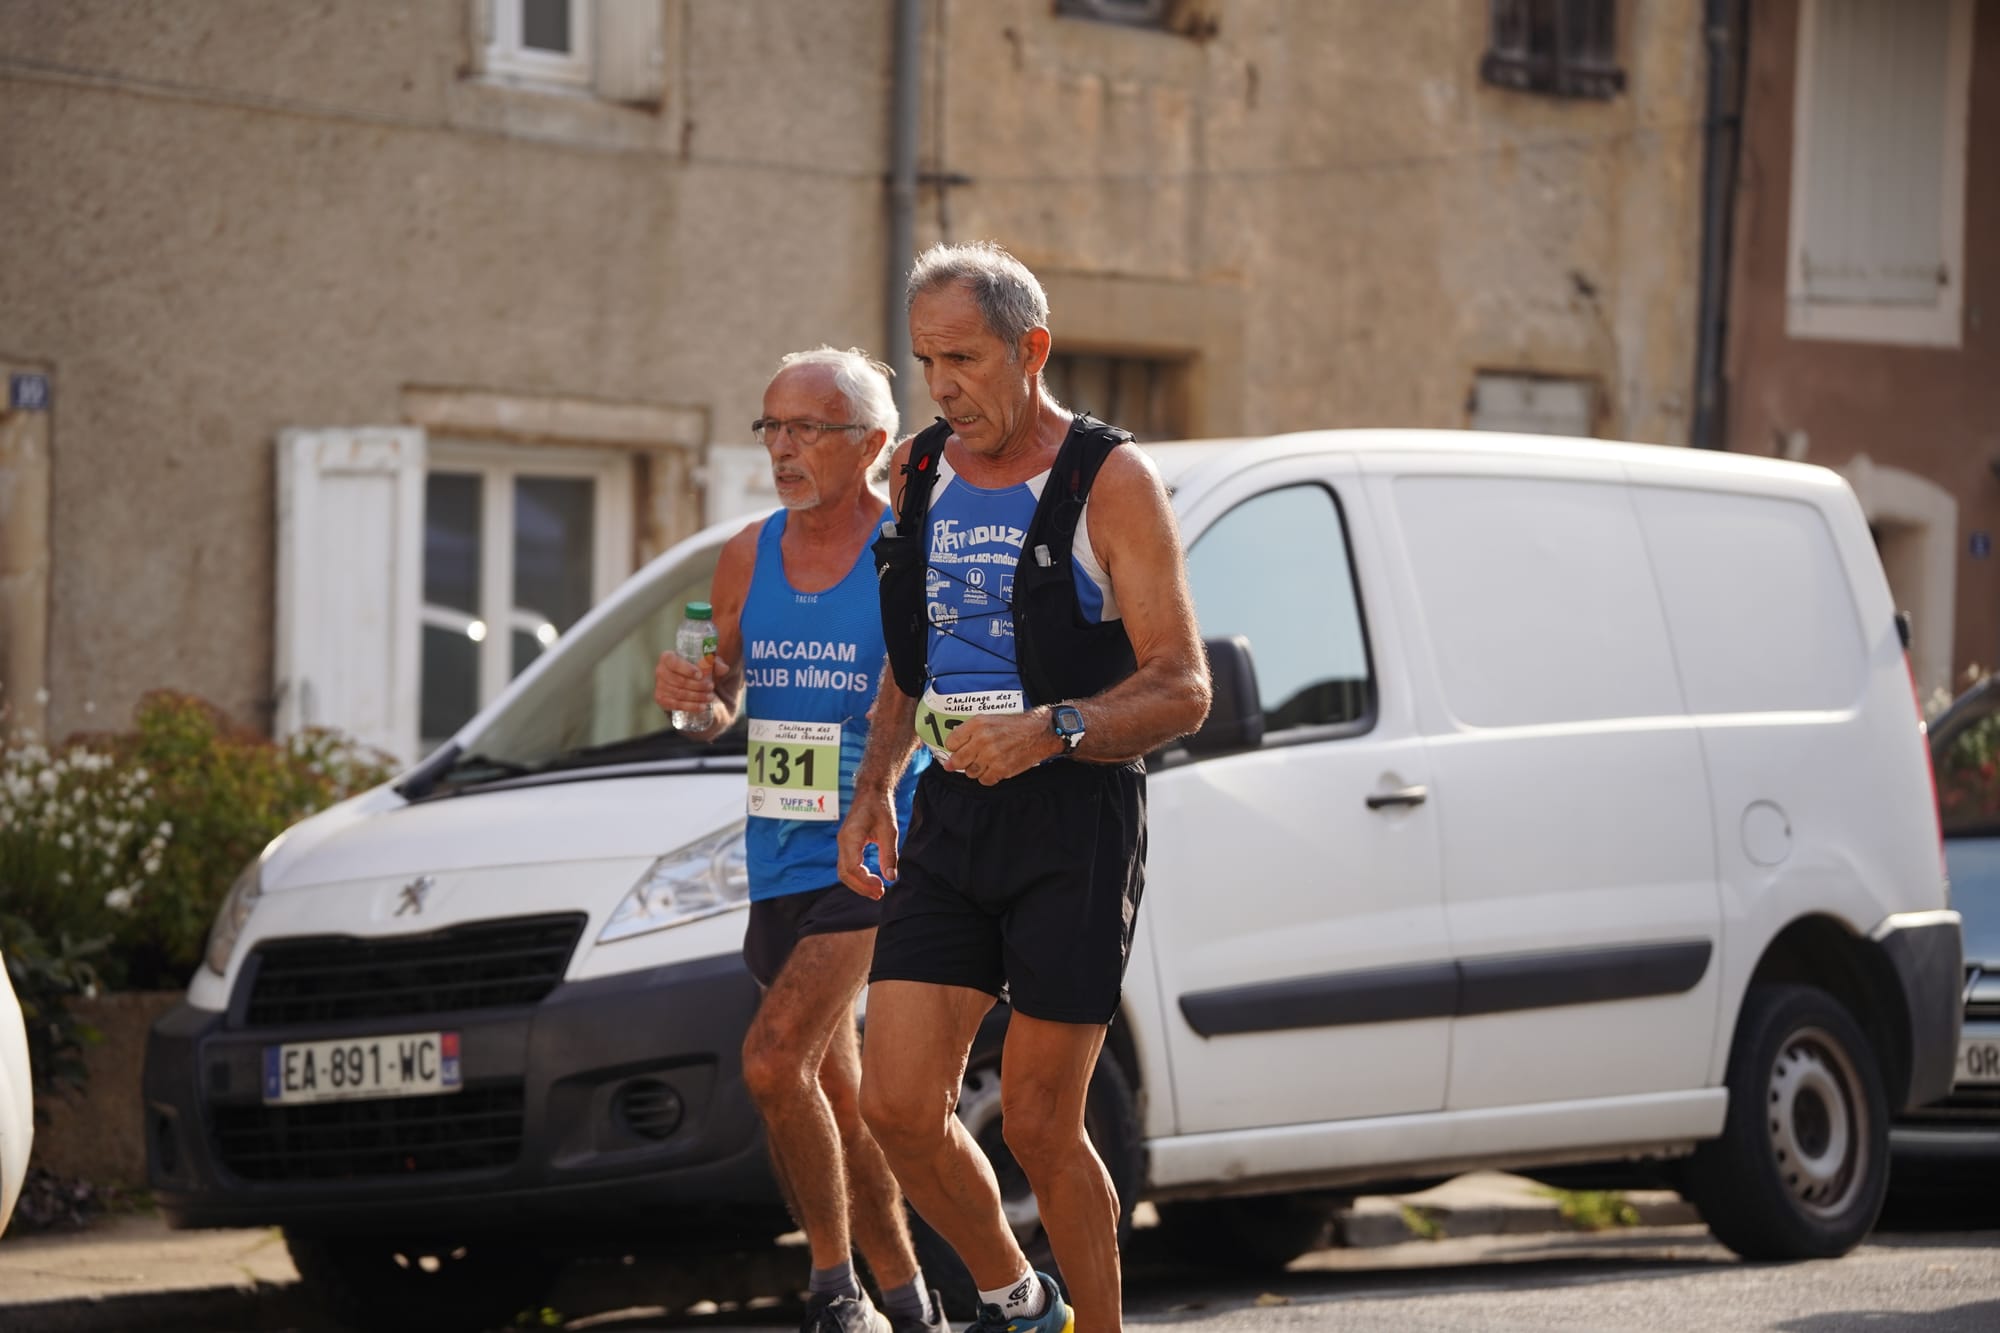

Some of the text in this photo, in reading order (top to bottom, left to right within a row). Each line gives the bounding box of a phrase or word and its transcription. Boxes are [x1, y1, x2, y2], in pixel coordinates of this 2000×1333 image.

[942, 525, 1028, 552] ANDUZ
[752, 640, 857, 663] MACADAM
[745, 665, 868, 692] CLUB NÎMOIS
[946, 693, 1012, 706] Challenge des
[977, 701, 1017, 711] cévenoles
[778, 723, 813, 735] Challenge
[755, 745, 815, 787] 131
[779, 797, 814, 807] TUFF'S
[284, 1039, 435, 1091] EA-891-WC
